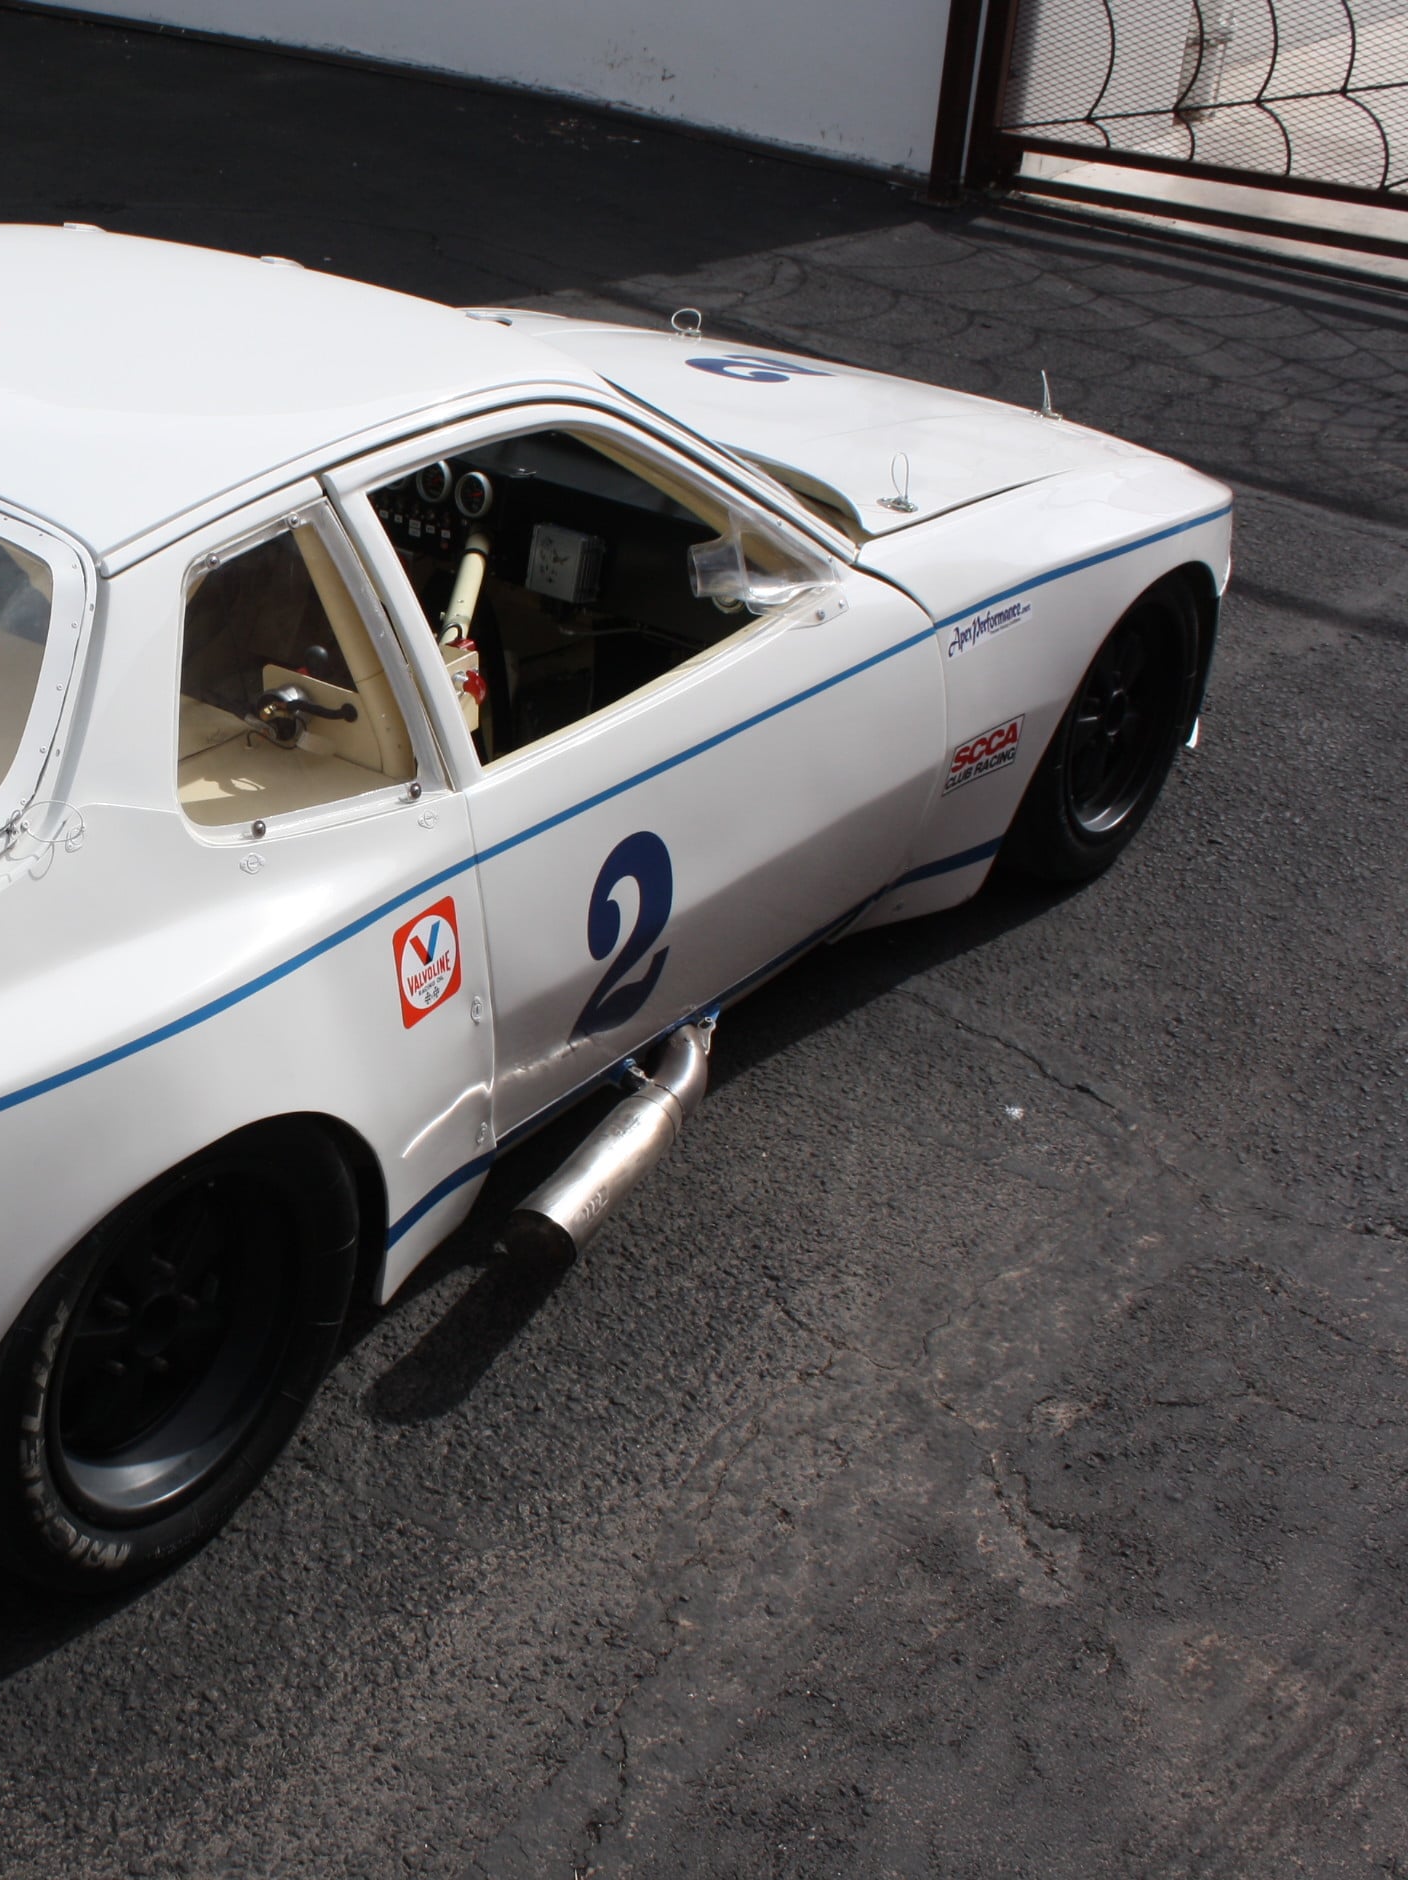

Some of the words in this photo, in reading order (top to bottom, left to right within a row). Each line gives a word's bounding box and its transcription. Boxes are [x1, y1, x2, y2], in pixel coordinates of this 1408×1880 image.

[685, 354, 837, 383] 2
[945, 766, 973, 790] CLUB
[973, 747, 1016, 776] RACING
[950, 722, 1018, 773] SCCA
[567, 830, 673, 1044] 2
[407, 950, 451, 997] VALVOLINE
